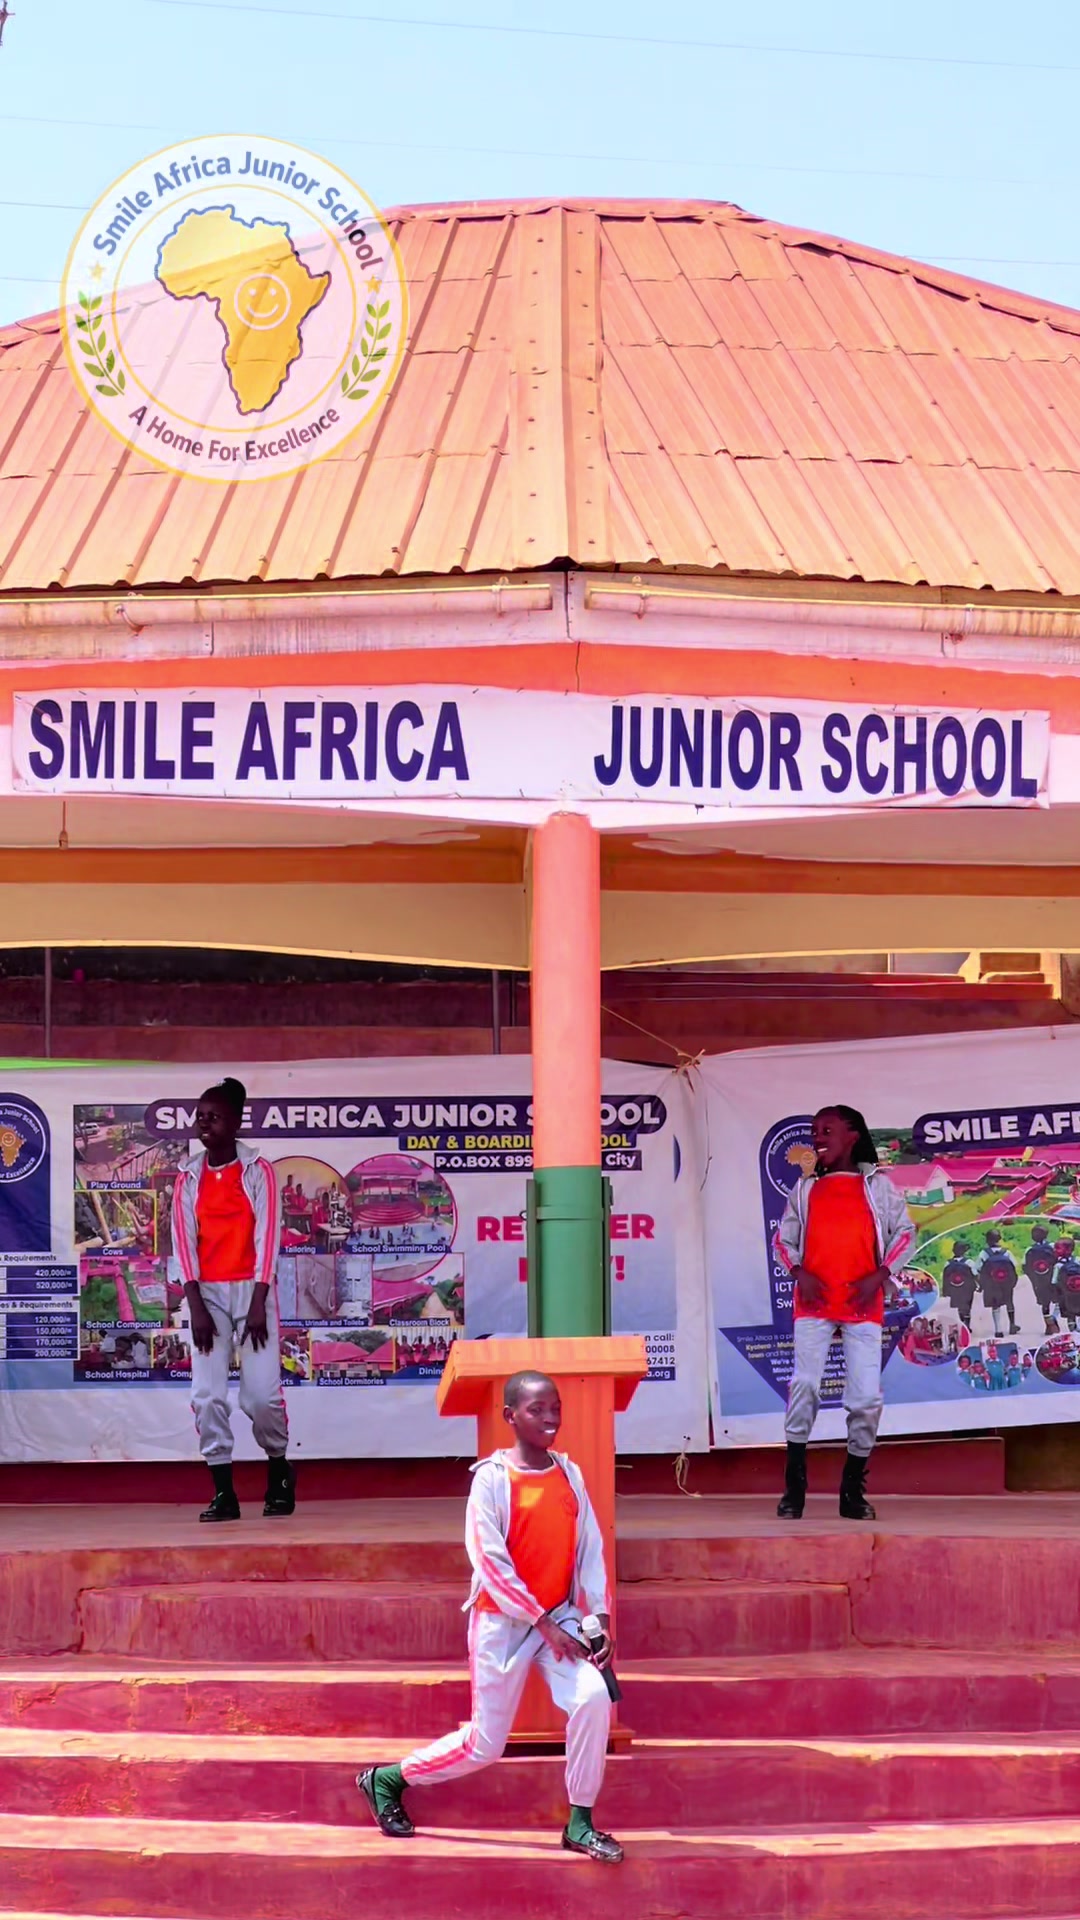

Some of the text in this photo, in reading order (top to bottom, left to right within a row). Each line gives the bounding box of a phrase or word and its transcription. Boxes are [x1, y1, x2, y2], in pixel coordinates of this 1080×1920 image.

[28, 698, 470, 782] SMILE AFRICA
[594, 704, 1038, 798] JUNIOR SCHOOL
[155, 1102, 660, 1130] SME AFRICA JUNIOR OOL
[923, 1115, 1020, 1144] SMILE
[407, 1136, 440, 1150] DAY
[446, 1136, 459, 1149] &
[464, 1135, 534, 1149] BOARDI
[435, 1155, 500, 1169] P.O.BOX
[605, 1152, 636, 1168] City
[91, 1181, 141, 1190] Play Ground
[477, 1213, 655, 1242] REER
[103, 1248, 123, 1256] Cows
[352, 1244, 445, 1253] School Swimming Pool
[4, 1254, 57, 1262] Requirements
[775, 1281, 793, 1293] ICT
[20, 1301, 73, 1309] Requirements
[86, 1320, 161, 1330] School Compound
[429, 1318, 449, 1326] Block
[653, 1333, 675, 1342] call:
[85, 1370, 149, 1379] School Hospital
